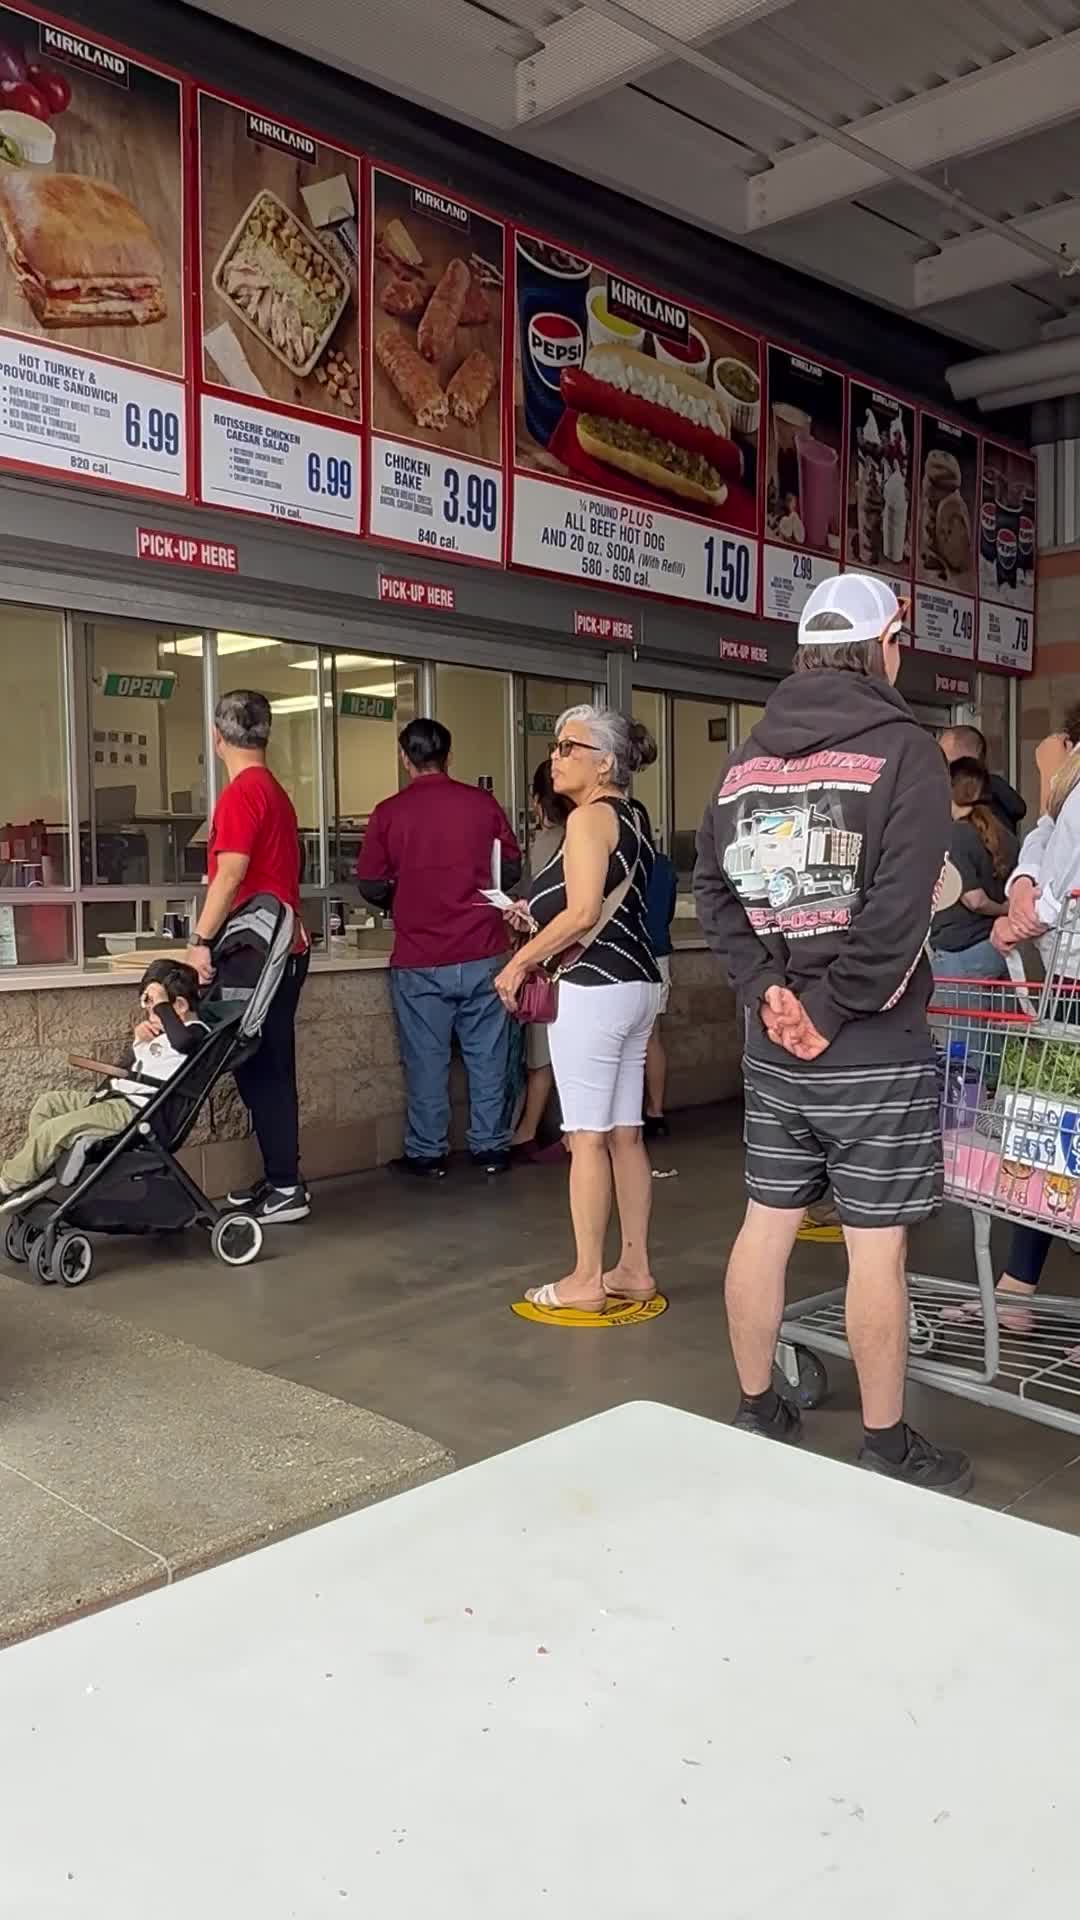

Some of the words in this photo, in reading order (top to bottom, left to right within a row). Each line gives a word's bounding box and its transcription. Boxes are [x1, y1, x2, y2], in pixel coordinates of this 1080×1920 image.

[45, 28, 125, 75] KIRKLAND
[250, 116, 314, 154] KIRKLAND
[414, 188, 468, 222] KIRKLAND
[610, 280, 686, 329] KIRKLAND
[532, 334, 581, 361] PEPSI
[18, 353, 40, 370] HOT
[44, 360, 85, 381] TURKEY
[88, 372, 96, 384] &
[63, 380, 118, 404] SANDWICH
[125, 402, 179, 456] 6.99
[213, 414, 264, 436] ROTISSERIE
[265, 426, 301, 445] CHICKEN
[226, 428, 260, 446] CAESAR
[262, 438, 290, 453] SALAD
[70, 456, 90, 470] 820
[92, 461, 112, 476] cal.
[308, 452, 352, 500] 6.99
[384, 452, 431, 478] CHICKEN
[394, 470, 422, 491] BAKE
[269, 504, 286, 516] 710
[287, 507, 302, 520] cal.
[443, 468, 497, 532] 3.99
[588, 501, 618, 520] POUND
[620, 507, 654, 529] PLUS
[418, 528, 437, 546] 840
[440, 535, 460, 550] cal.
[564, 512, 586, 532] ALL
[590, 518, 617, 538] BEEF
[620, 524, 642, 545] HOT
[644, 530, 665, 552] DOG
[141, 532, 198, 562] PICK-UP
[200, 544, 236, 569] HERE
[541, 526, 567, 548] AND
[570, 534, 584, 552] 20
[588, 541, 602, 556] oz.
[606, 542, 635, 564] SODA
[638, 553, 660, 570] (With
[661, 558, 686, 578] Refill)
[582, 557, 602, 576] 580
[612, 564, 631, 583] 850
[634, 570, 651, 588] cal.
[704, 536, 750, 603] 1.50
[792, 554, 812, 580] 2.99
[381, 578, 425, 604] PICK-UP
[427, 588, 454, 608] HERE
[577, 614, 612, 635] PICK-UP
[612, 622, 634, 640] HERE
[952, 608, 972, 640] 2.49
[1012, 616, 1028, 652] .79
[722, 641, 750, 659] PICK-UP
[750, 647, 768, 662] HERE
[118, 676, 164, 696] OPEN
[350, 696, 384, 716] OPEN
